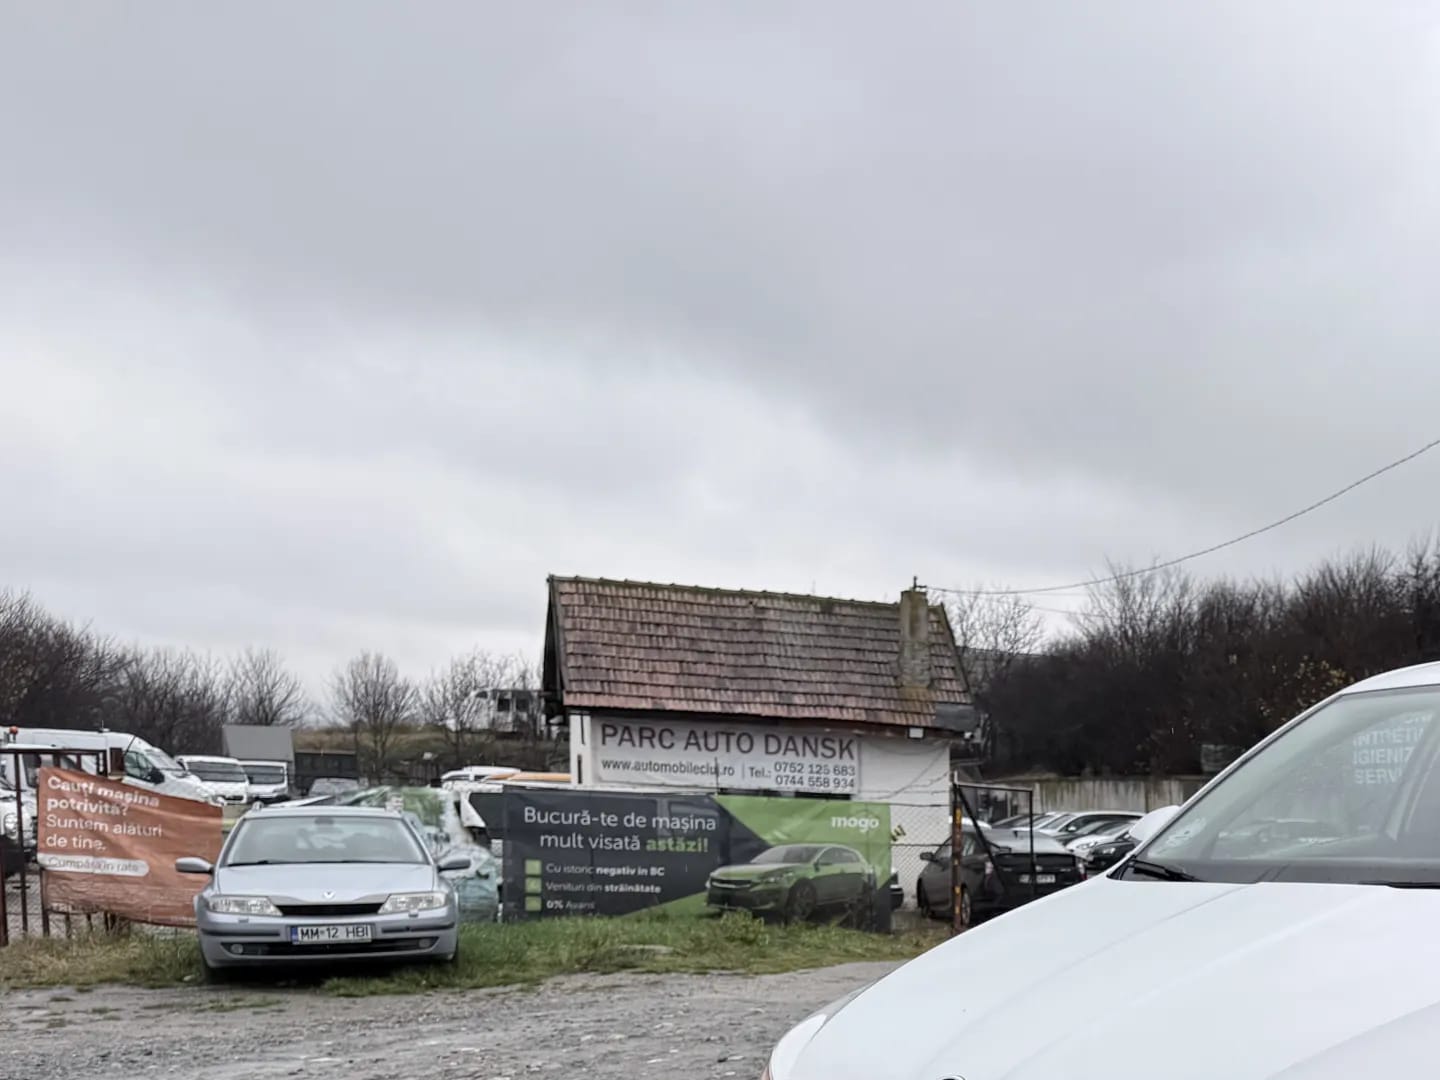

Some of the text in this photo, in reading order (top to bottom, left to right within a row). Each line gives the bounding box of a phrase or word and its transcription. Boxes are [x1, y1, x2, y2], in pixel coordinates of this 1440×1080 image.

[601, 723, 854, 760] PARC AUTO DANSK
[775, 774, 804, 786] 0744
[46, 814, 109, 833] Suntem
[524, 806, 716, 833] Bucură-te de mașina
[831, 816, 879, 833] mogo
[46, 834, 68, 848] de
[540, 832, 709, 853] mult visată astăzi!
[546, 863, 561, 874] Cu
[563, 863, 594, 875] istoric
[596, 864, 636, 877] negativ
[650, 866, 665, 877] BC
[546, 900, 564, 910] 0%
